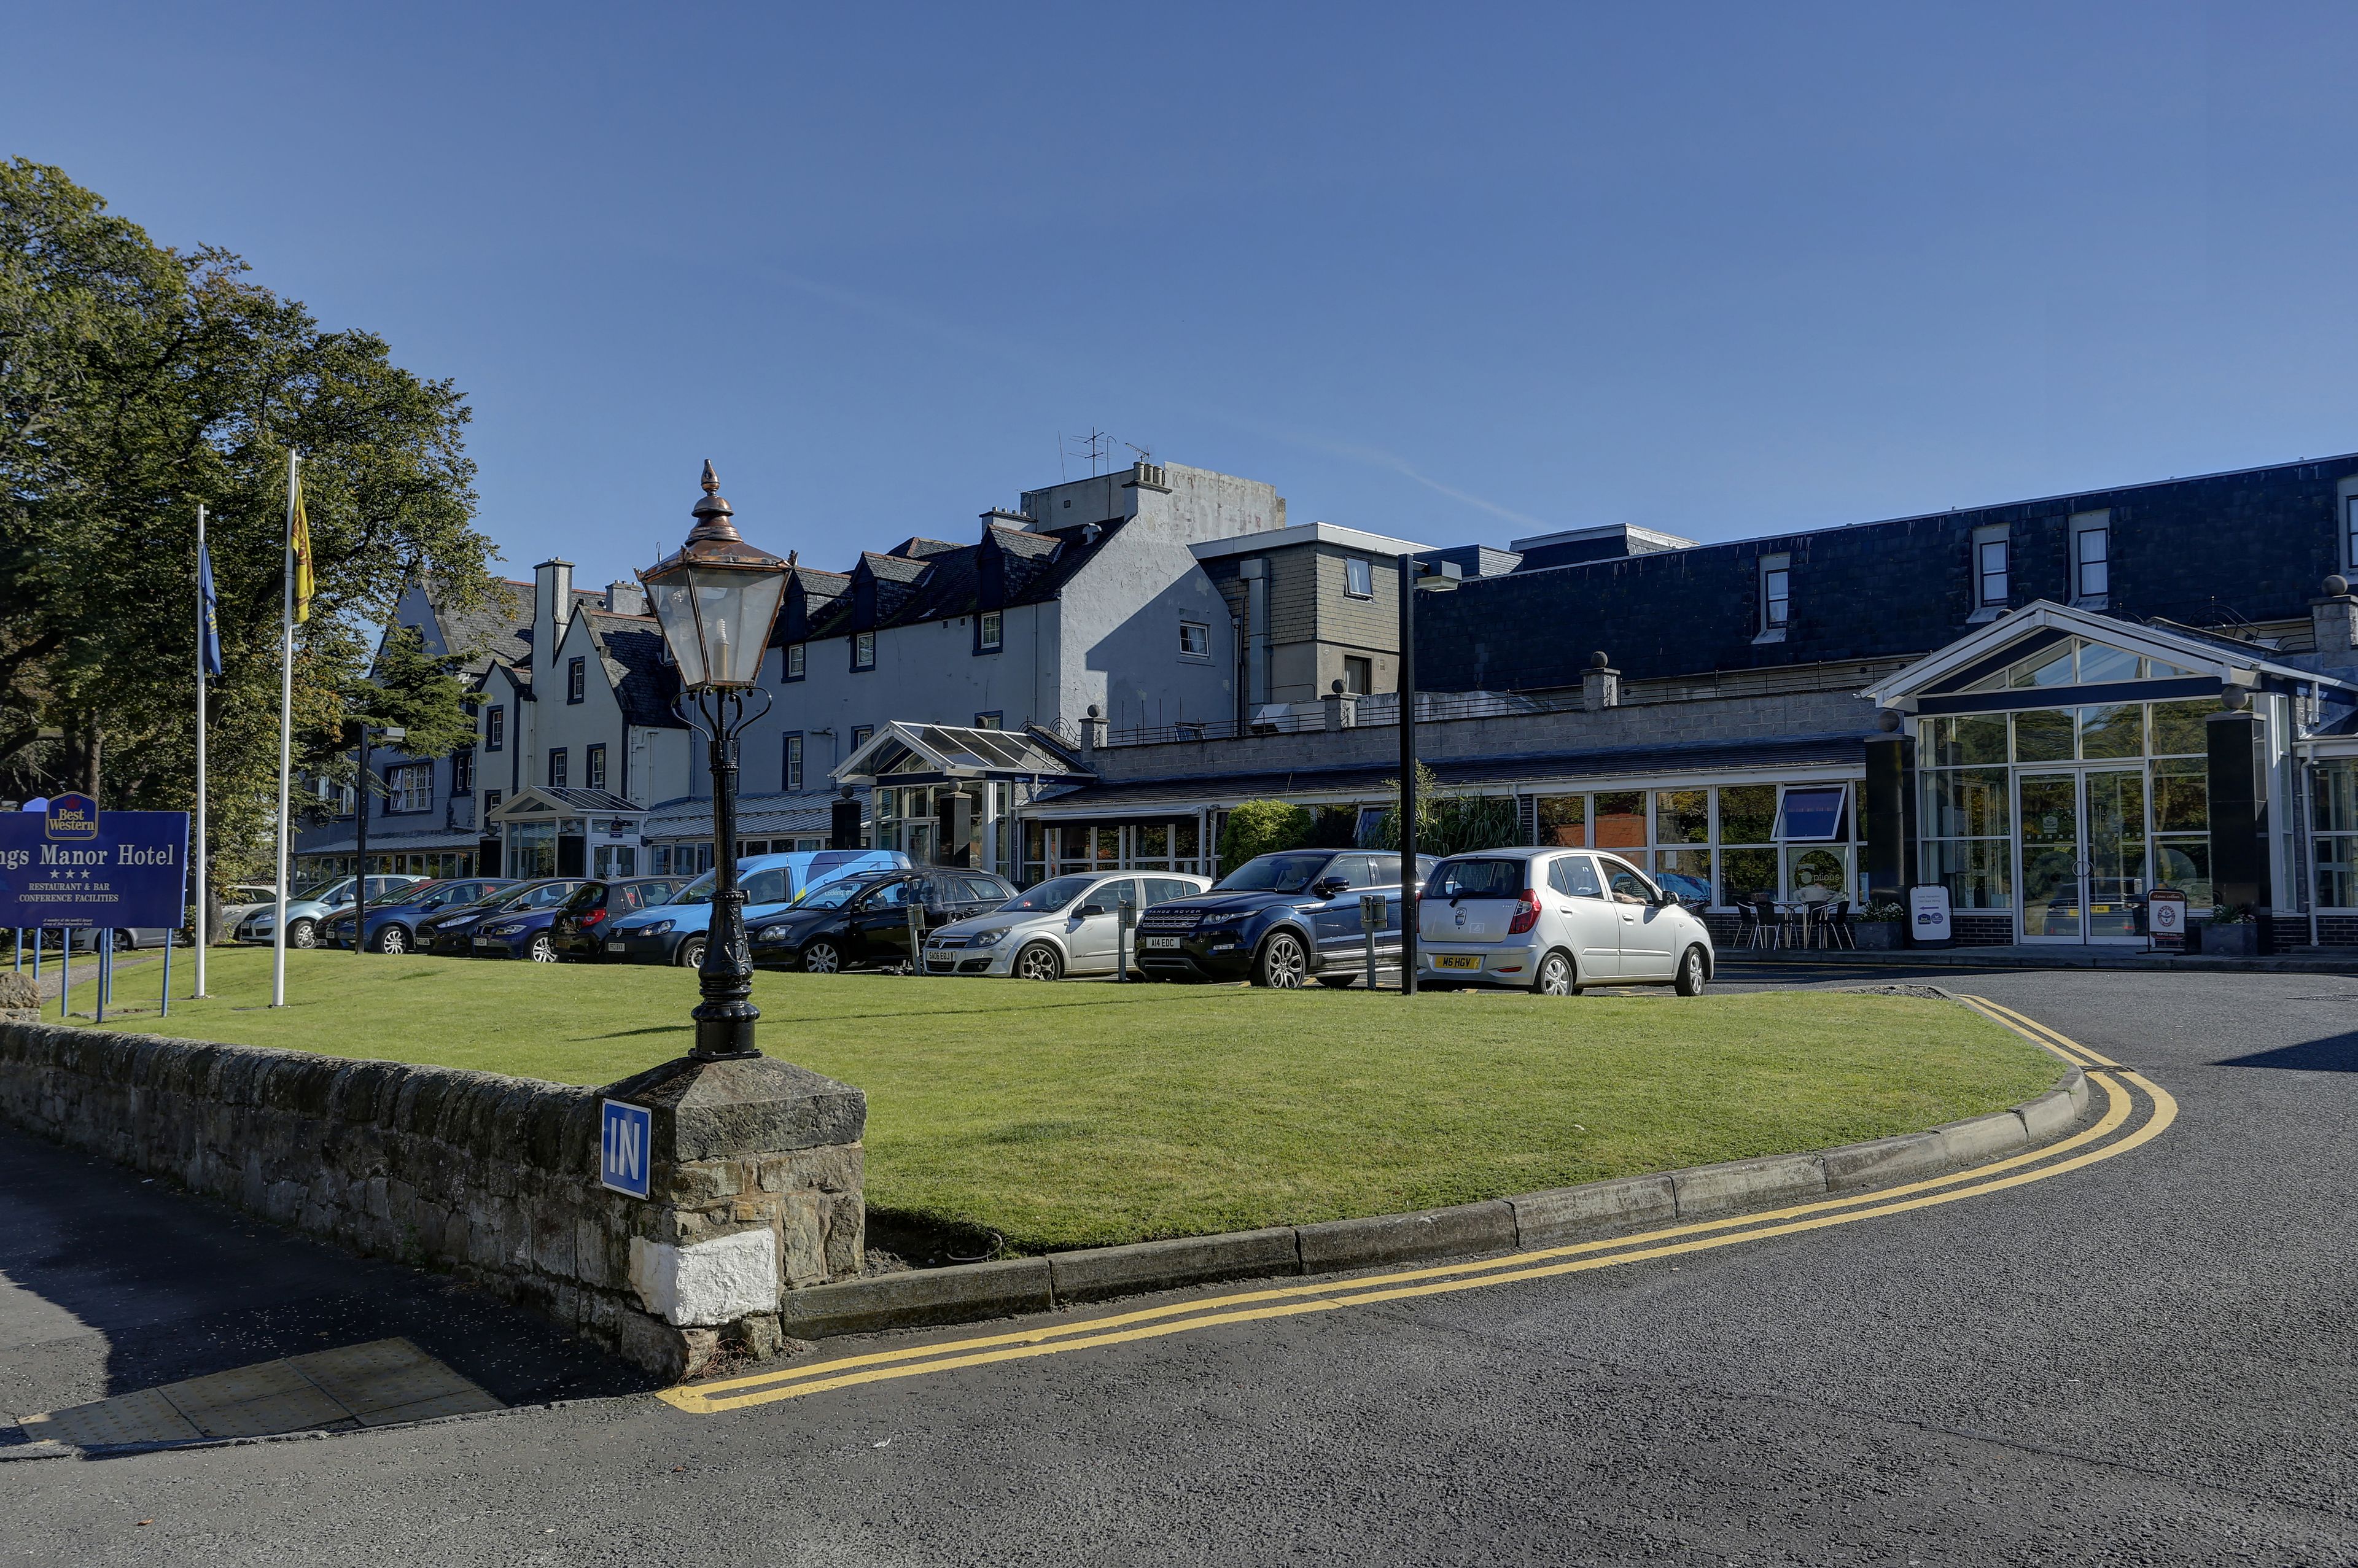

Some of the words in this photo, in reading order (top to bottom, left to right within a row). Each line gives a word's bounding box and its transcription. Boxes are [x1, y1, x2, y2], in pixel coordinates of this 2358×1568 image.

[59, 809, 85, 820] Best
[49, 819, 95, 831] Western
[39, 844, 108, 865] Manor
[117, 844, 174, 865] Hotel
[75, 894, 119, 902] FACILITIES
[1454, 958, 1471, 967] HGV
[610, 1117, 640, 1181] IN
